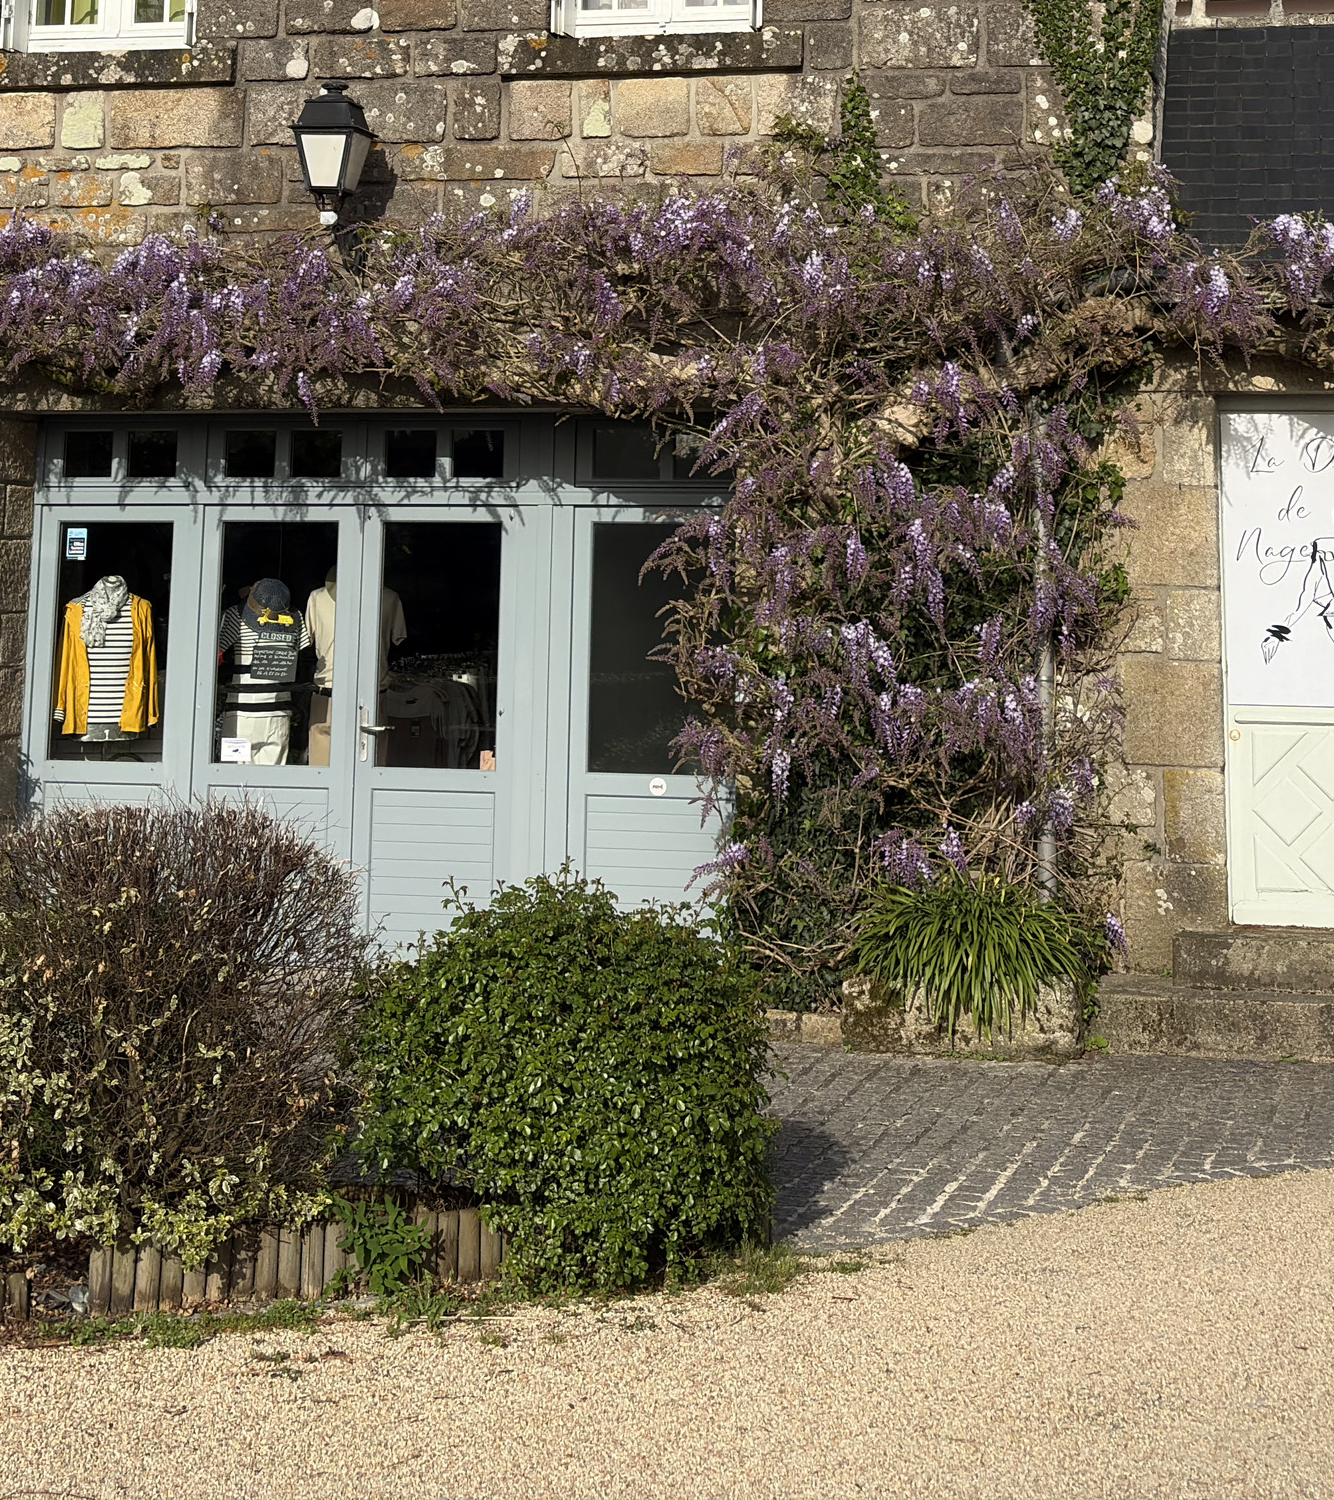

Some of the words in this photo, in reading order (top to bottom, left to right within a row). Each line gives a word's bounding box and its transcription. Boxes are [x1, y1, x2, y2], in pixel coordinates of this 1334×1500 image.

[1244, 435, 1285, 473] La
[1277, 485, 1312, 522] de
[1236, 527, 1313, 585] Nage
[260, 632, 292, 641] CLOSED
